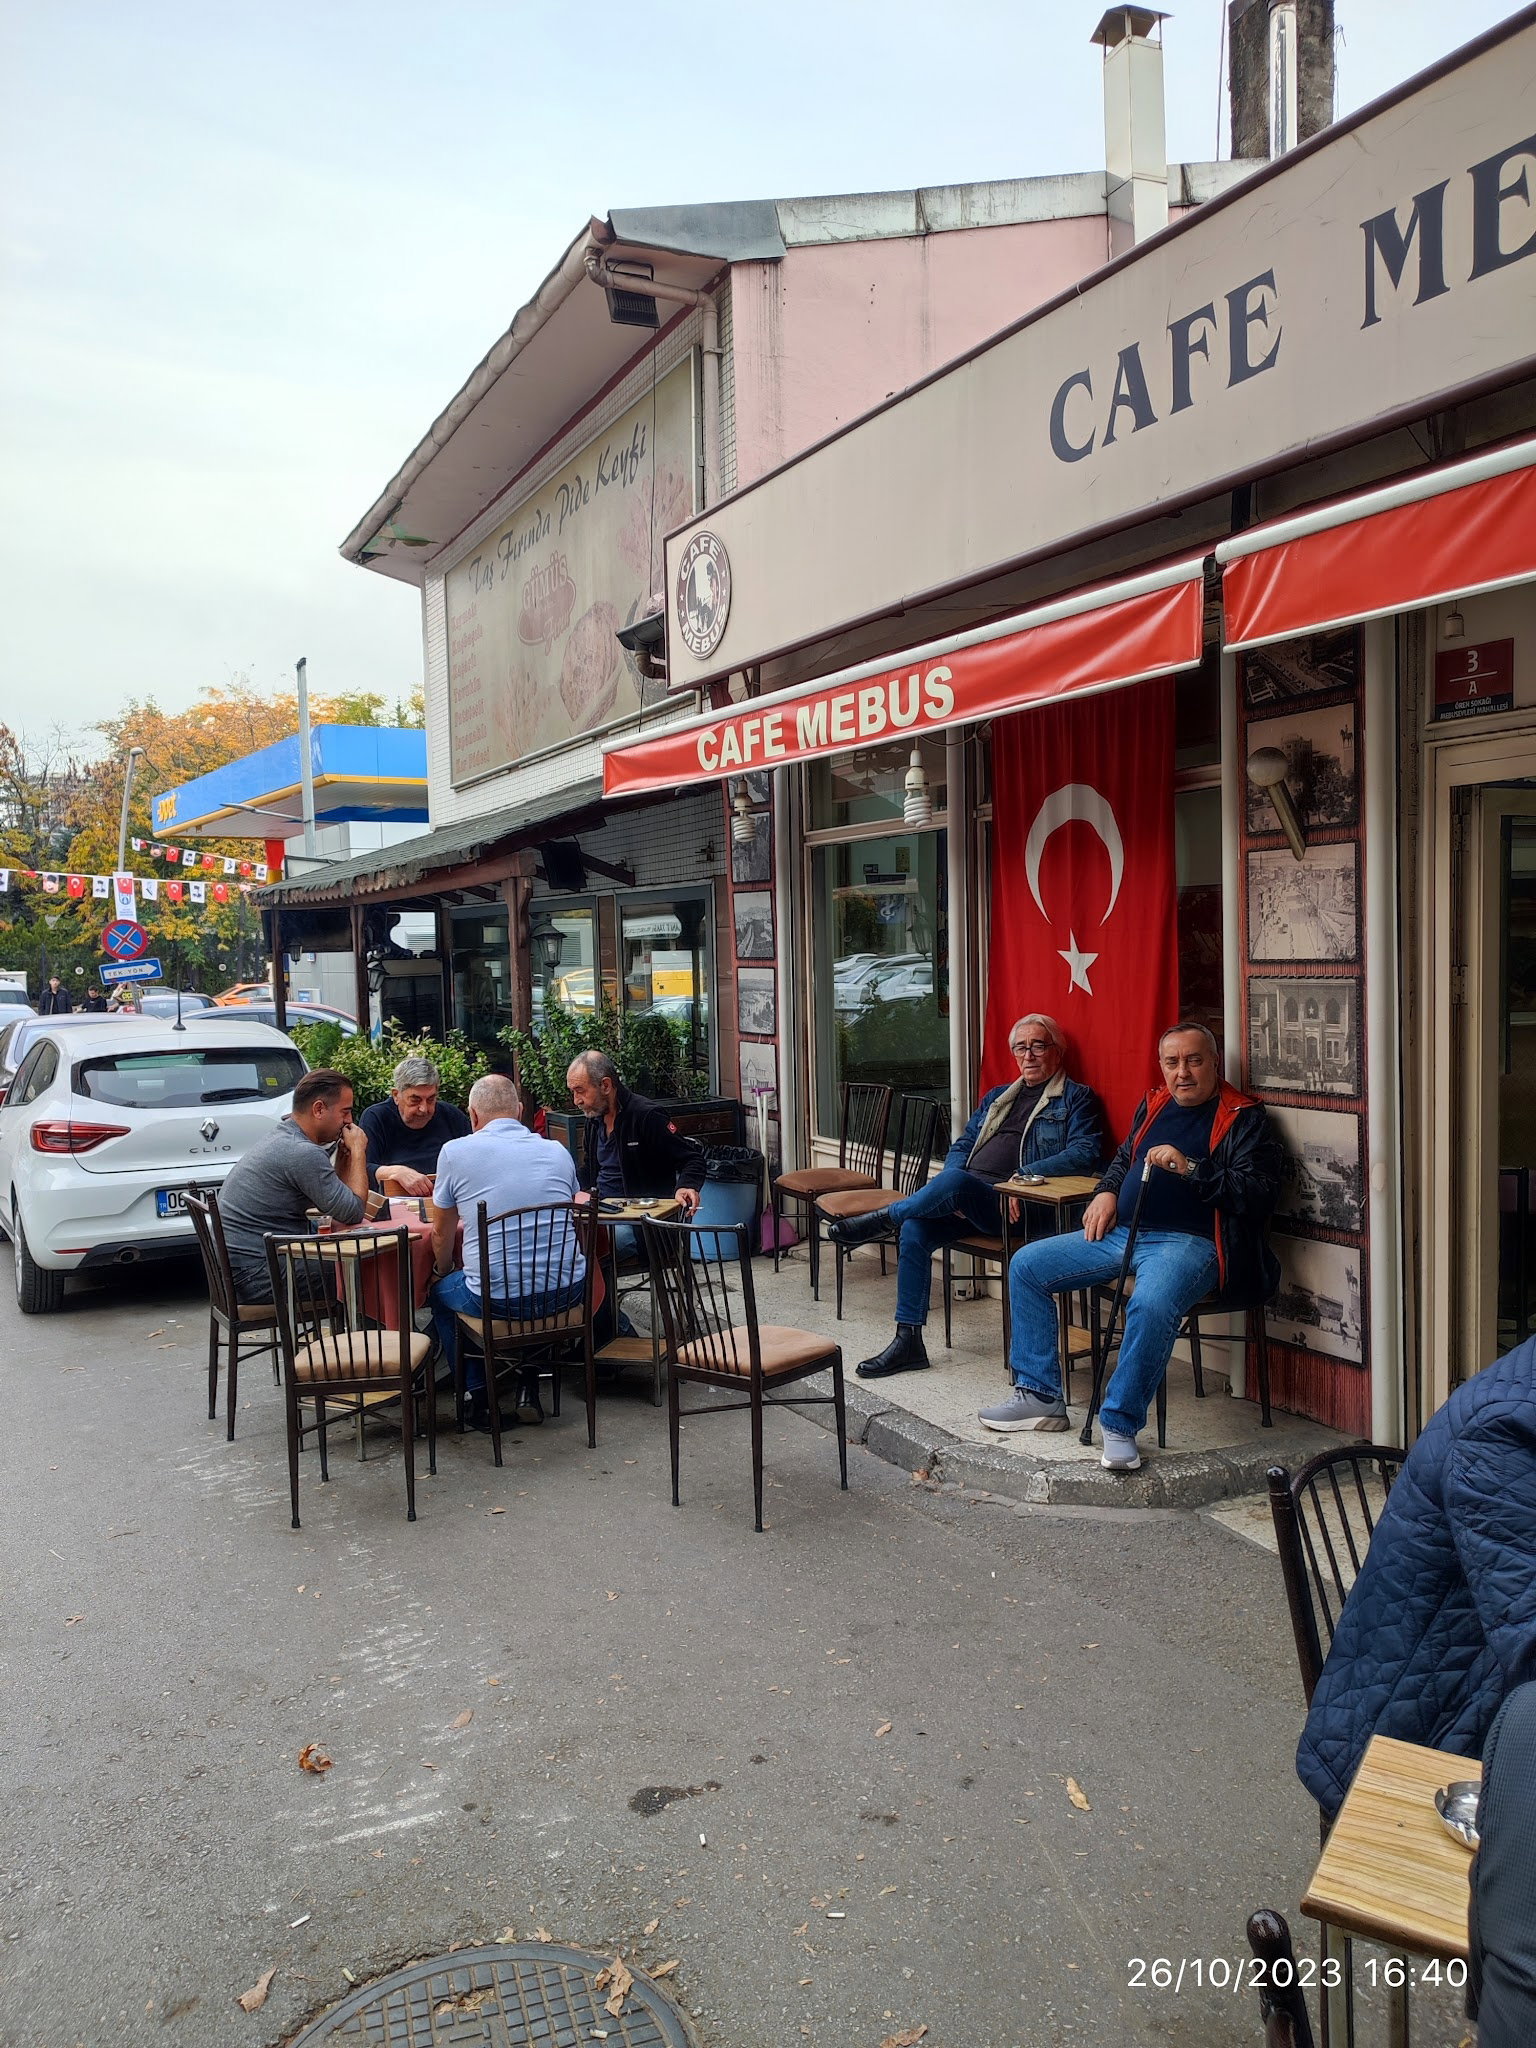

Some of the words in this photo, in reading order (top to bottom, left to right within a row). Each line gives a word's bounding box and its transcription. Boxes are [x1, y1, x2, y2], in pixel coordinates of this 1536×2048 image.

[1049, 267, 1283, 463] CAFE
[468, 555, 494, 595] Taş
[555, 475, 590, 536] Pide
[595, 422, 647, 496] Keyfi
[681, 536, 720, 581] CAFE
[682, 603, 727, 653] MEBUS
[1467, 650, 1478, 673] 3
[1468, 681, 1478, 695] A
[697, 712, 786, 772] CAFE
[796, 666, 955, 751] MEBUS
[189, 1145, 232, 1154] CLIO
